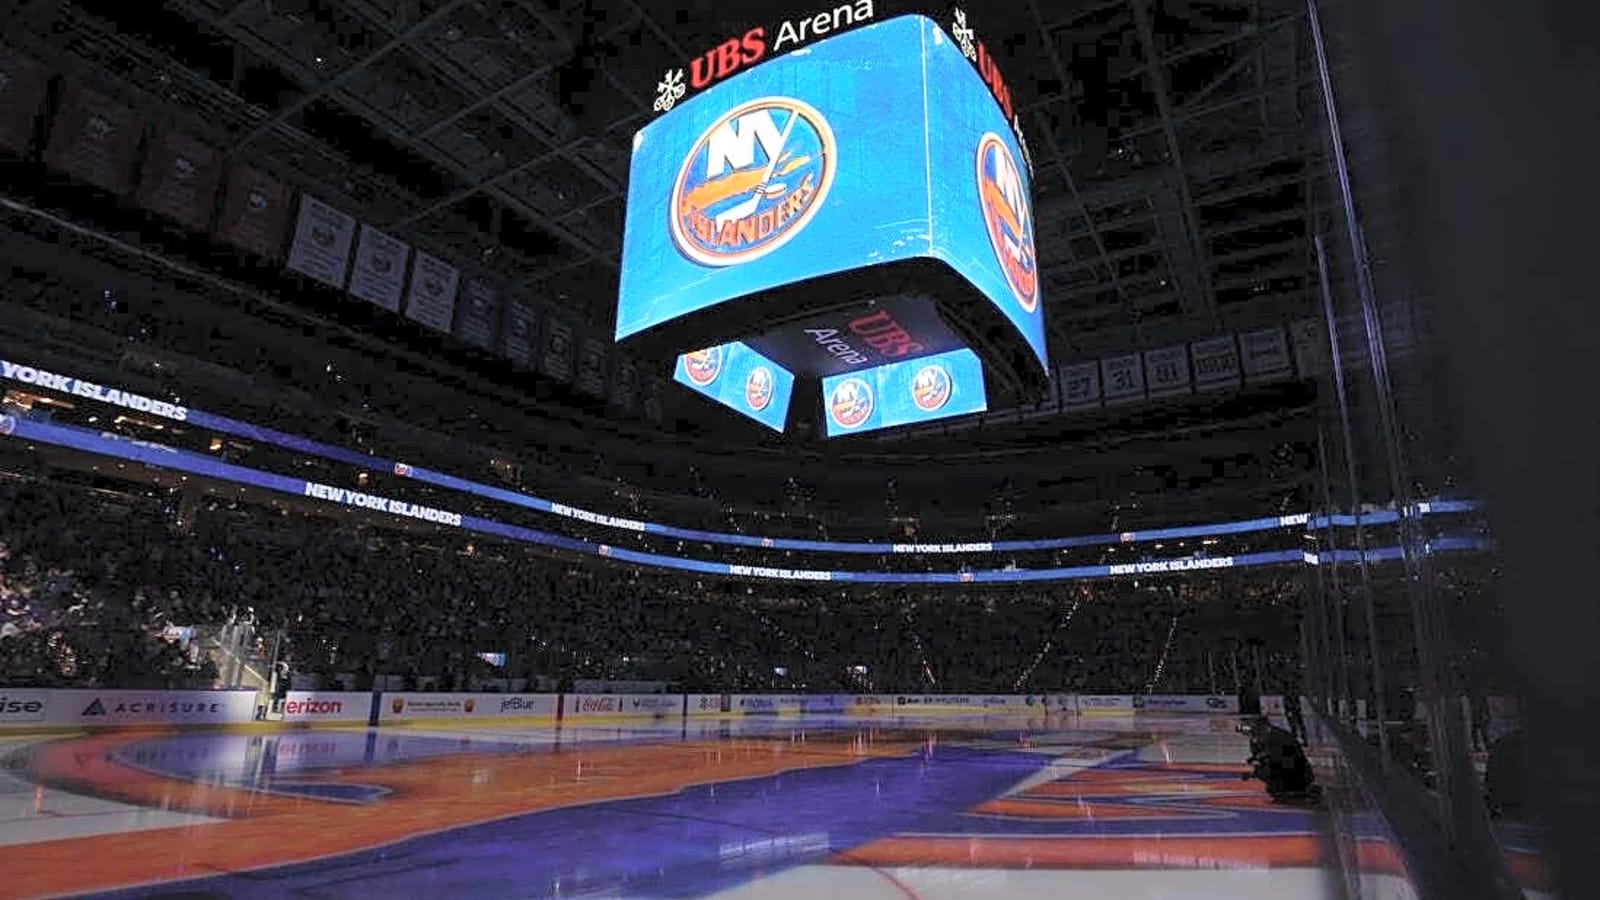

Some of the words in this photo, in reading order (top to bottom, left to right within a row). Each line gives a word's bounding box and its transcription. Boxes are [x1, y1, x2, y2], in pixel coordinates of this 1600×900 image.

[688, 26, 767, 89] UBS
[772, 0, 875, 52] Arena
[706, 109, 799, 180] NY
[684, 172, 814, 247] ISLANDERS
[803, 327, 868, 364] Arena
[847, 309, 924, 358] UBS
[0, 360, 73, 394] YORK
[72, 378, 188, 422] ISLANDERS
[304, 482, 343, 502] NEW
[343, 489, 389, 513] YORK
[388, 499, 463, 527] ISLANDERS
[551, 502, 574, 517] NEW
[573, 507, 596, 523] YORK
[596, 514, 645, 532] ISLANDERS
[1279, 512, 1310, 527] NEW
[893, 543, 915, 553] NEW
[914, 543, 941, 553] YORK
[941, 542, 993, 553] ISLANDERS
[1110, 563, 1136, 575] NEW
[1136, 561, 1169, 573] YORK
[1169, 556, 1233, 571] ISLANDERS
[730, 564, 753, 576] NEW
[752, 565, 779, 578] YORK
[779, 569, 831, 581] ISLANDERS
[114, 700, 219, 714] ACRISURE
